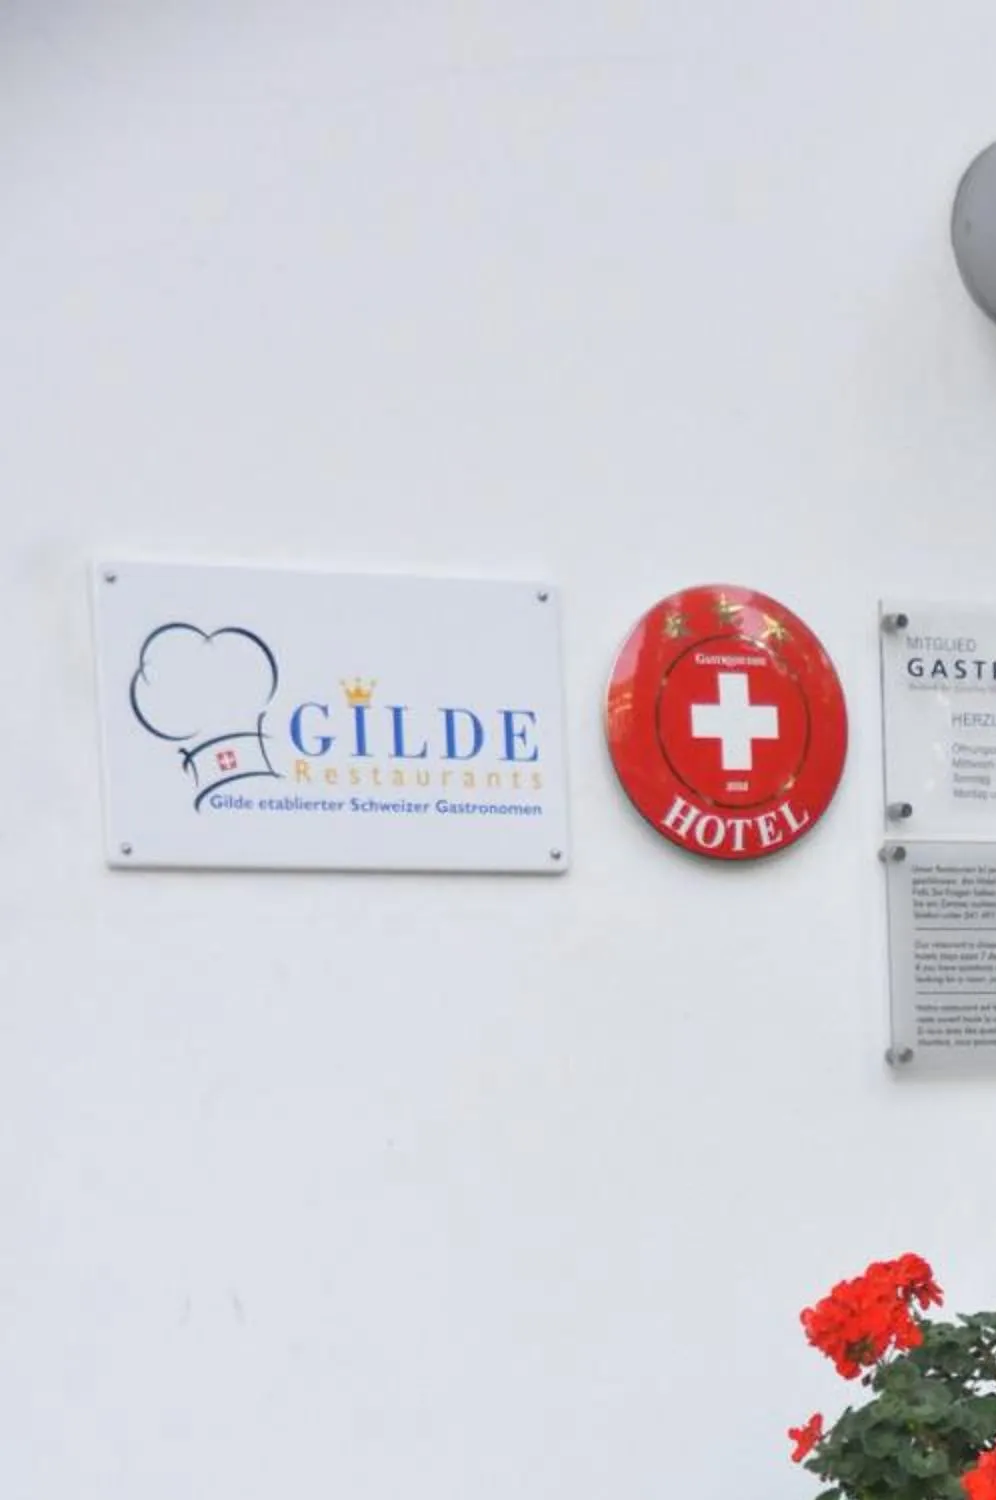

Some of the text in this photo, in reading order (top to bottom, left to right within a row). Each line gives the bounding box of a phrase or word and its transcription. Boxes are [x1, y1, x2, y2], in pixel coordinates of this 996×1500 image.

[906, 637, 976, 652] MITGLIED
[289, 701, 540, 762] GILDE
[293, 759, 543, 790] Restaurants
[209, 794, 543, 817] Gilde etablierter Schweizer Gastronomen
[660, 795, 810, 851] HOTEL
